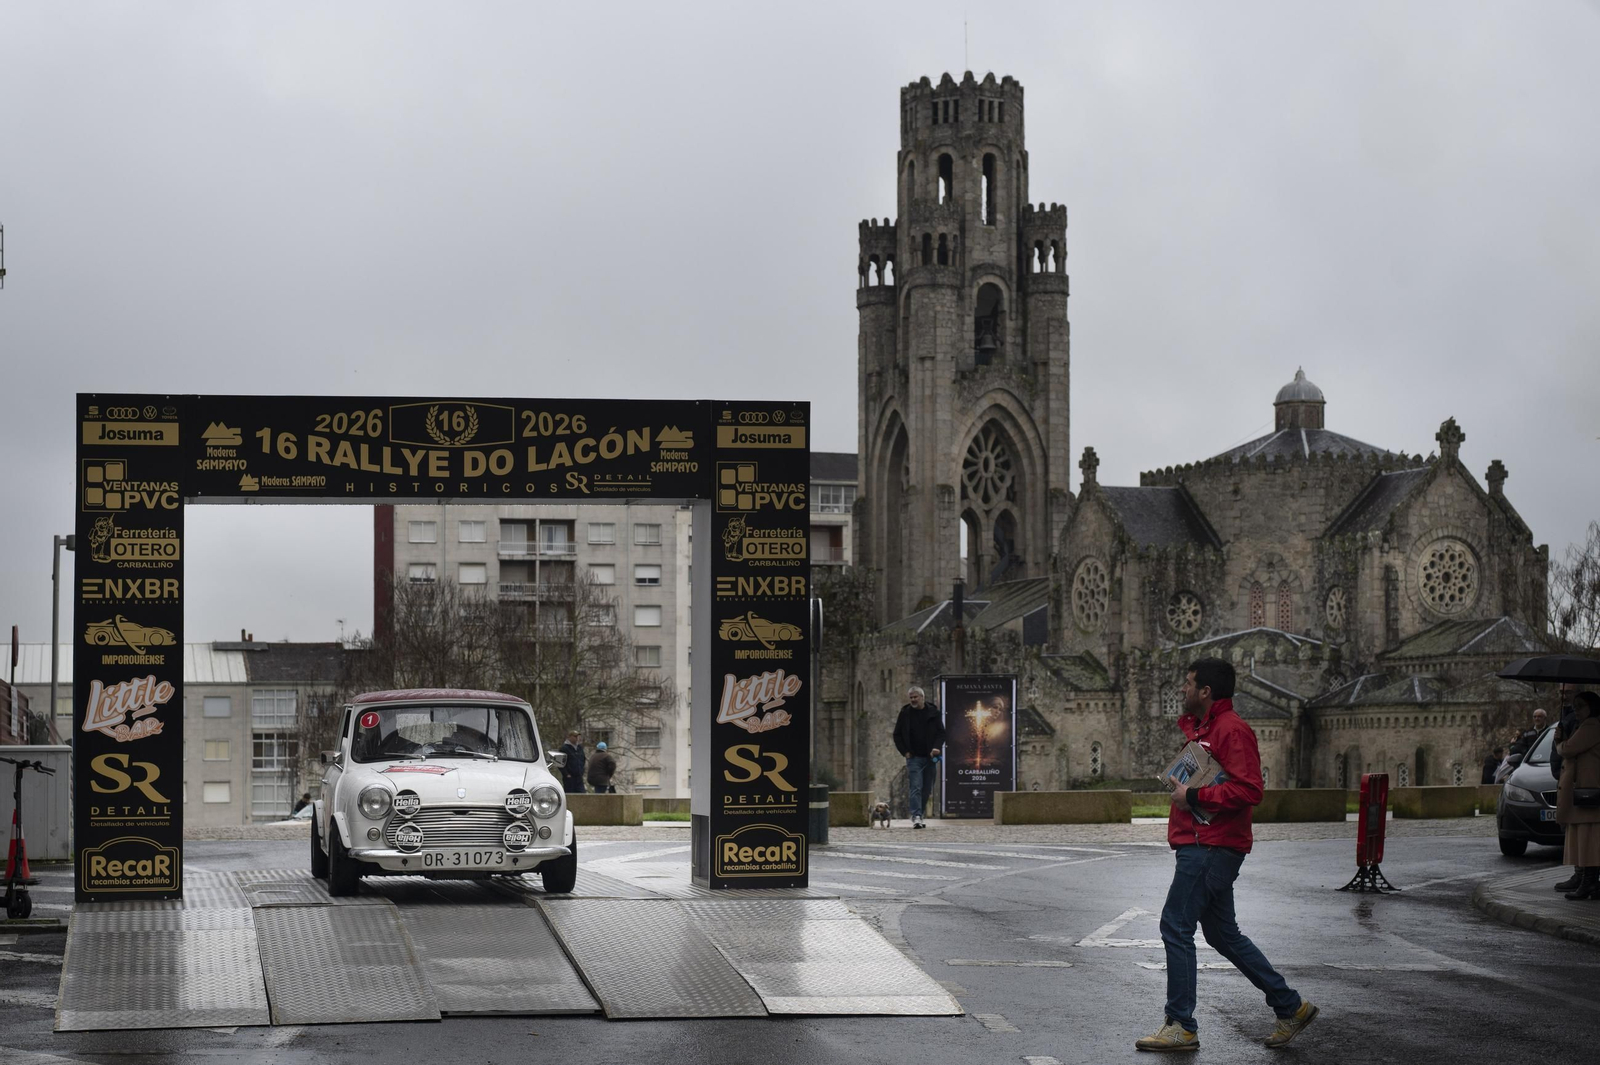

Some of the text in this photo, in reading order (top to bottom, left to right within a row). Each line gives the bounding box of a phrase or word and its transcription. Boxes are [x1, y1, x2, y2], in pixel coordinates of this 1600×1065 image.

[314, 409, 383, 437] 2026
[438, 410, 465, 432] 16
[521, 410, 587, 437] 2026
[98, 423, 164, 440] Josuma
[731, 427, 791, 444] Josuma
[207, 447, 236, 457] Maderas
[256, 426, 651, 477] 16 RALLYE DO LACÓN
[660, 450, 688, 460] Maderas
[196, 459, 247, 471] SAMPAYO
[650, 462, 698, 473] SAMPAYO
[103, 481, 179, 491] VENTANAS
[261, 476, 326, 487] Maderas SAMPAYO
[346, 482, 557, 493] HISTORICOS
[735, 483, 805, 492] VENTANAS
[124, 492, 179, 510] PVC
[755, 493, 805, 510] PVC
[114, 526, 176, 538] Ferretería
[745, 527, 803, 538] Ferretería
[114, 543, 176, 556] OTERO
[746, 542, 803, 555] OTERO
[116, 560, 174, 569] CARBALLIÑO
[748, 559, 801, 567] CARBALLIÑO
[82, 579, 179, 598] ENXBR
[717, 577, 805, 595] ENXBR
[102, 655, 165, 665] IMPOROURENSE
[735, 650, 793, 659] IMPOROURENSE
[716, 669, 802, 723] Little
[82, 675, 175, 732] Little
[367, 715, 373, 724] 1
[747, 709, 792, 733] BAR
[115, 717, 164, 742] BAR
[724, 744, 798, 791] SR
[90, 753, 171, 803] SR
[395, 798, 419, 806] Hella
[507, 797, 530, 805] Hella
[724, 795, 798, 803] DETAIL
[91, 806, 171, 815] DETAIL
[397, 834, 421, 842] Hella
[505, 834, 529, 842] Hella
[724, 842, 797, 863] RecaR
[91, 855, 170, 877] RecaR
[761, 862, 797, 870] carballiño
[132, 877, 170, 885] carballiño
